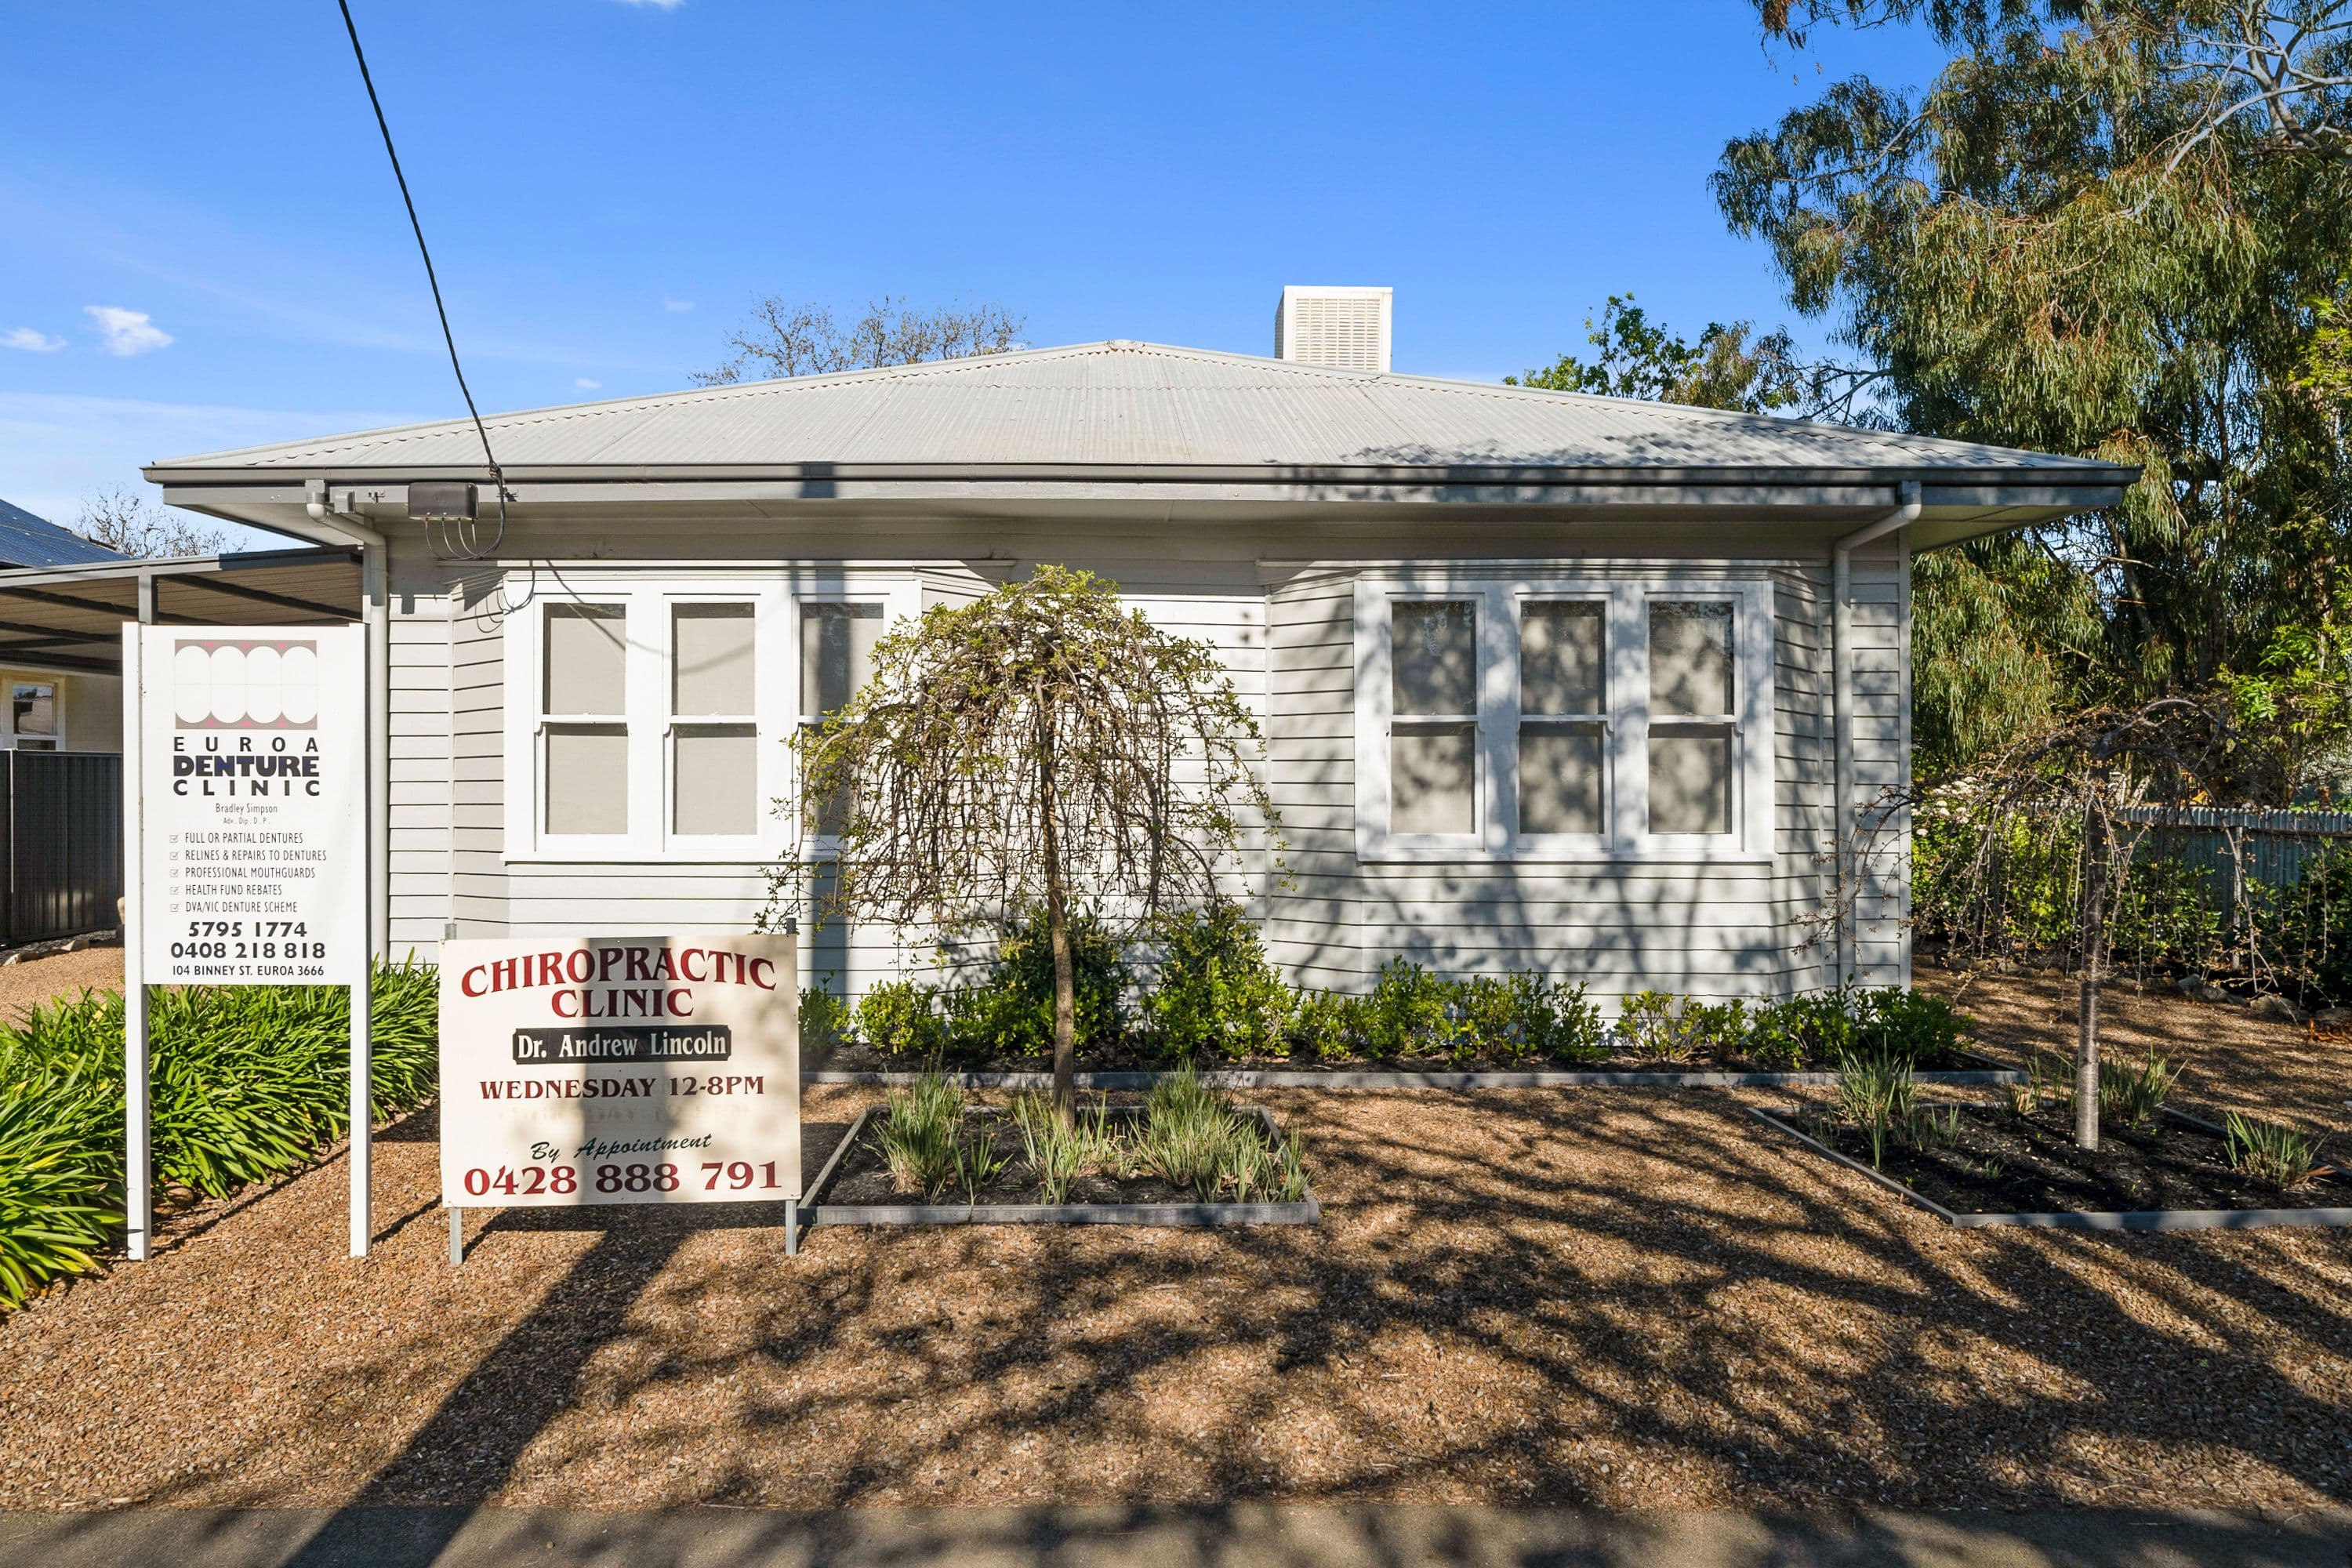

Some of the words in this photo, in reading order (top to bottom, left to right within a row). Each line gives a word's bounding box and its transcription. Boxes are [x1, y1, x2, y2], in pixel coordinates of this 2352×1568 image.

[173, 736, 318, 752] EUROA
[172, 756, 319, 777] DENTURE
[172, 779, 320, 797] CLINIC
[216, 803, 244, 815] Bradley
[247, 804, 278, 815] Simpson
[185, 833, 205, 843] FULL
[208, 833, 220, 843] OR
[223, 833, 257, 843] PARTIAL
[260, 833, 303, 844] DENTURES
[185, 850, 220, 860] RELINES
[223, 850, 229, 860] &
[232, 850, 266, 860] REPAIRS
[270, 850, 280, 860] TO
[283, 850, 326, 861] DENTURES
[186, 867, 248, 877] PROFESSIONAL
[251, 867, 315, 878] MOUTHGUARDS
[186, 884, 217, 895] HEALTH
[220, 884, 243, 895] FUND
[247, 884, 282, 895] REBATES
[186, 902, 219, 913] DVA/VIC
[223, 902, 261, 912] DENTURE
[264, 902, 298, 913] SCHEME
[188, 922, 242, 938] 5795
[255, 922, 307, 938] 1774
[171, 942, 227, 959] 0408
[235, 942, 276, 959] 218
[284, 942, 325, 959] 818
[172, 966, 191, 975] 104
[194, 966, 236, 975] BINNEY
[238, 966, 253, 975] ST.
[258, 966, 294, 975] EUROA
[297, 966, 324, 975] 3666
[461, 946, 777, 998] CHIROPRACTIC
[551, 989, 695, 1018] CLINIC
[517, 1034, 546, 1058] Dr.
[559, 1034, 637, 1058] Andrew
[650, 1031, 727, 1055] Lincoln
[480, 1078, 657, 1099] WEDNESDAY
[670, 1076, 764, 1096] 12-8PM
[531, 1142, 560, 1163] By
[574, 1134, 713, 1160] Appointment
[464, 1165, 577, 1196] 0428
[596, 1163, 680, 1193] 888
[700, 1160, 782, 1190] 791
